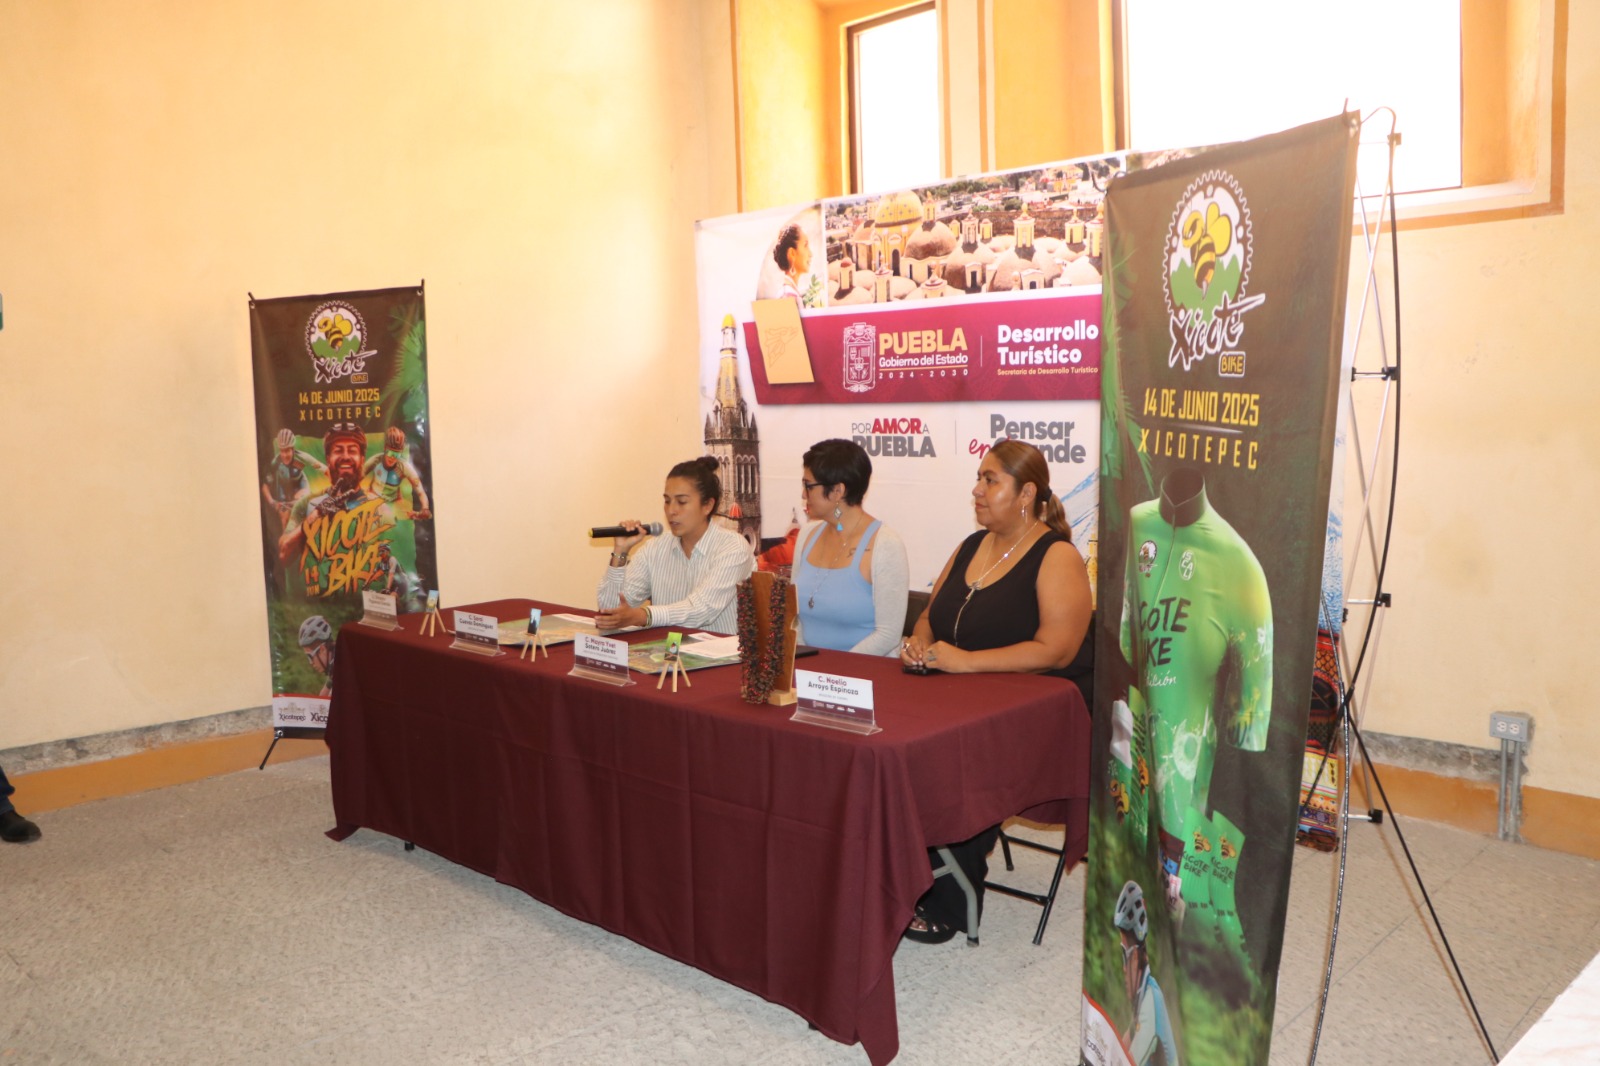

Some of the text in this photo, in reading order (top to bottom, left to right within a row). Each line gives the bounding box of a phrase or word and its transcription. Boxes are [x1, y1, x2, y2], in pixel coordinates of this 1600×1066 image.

[879, 327, 968, 355] PUEBLA
[998, 319, 1099, 344] Desarrollo
[879, 352, 968, 367] Gobierno del Estado
[997, 344, 1082, 365] Turístico
[1221, 355, 1244, 373] BIKE
[1037, 367, 1069, 375] Desarrollo
[299, 388, 380, 405] 14 DE JUNIO 2025
[300, 406, 381, 421] XICOTEPEC
[1143, 387, 1260, 427] 14 DE JUNIO 2025
[851, 417, 930, 434] POR AMOR A
[990, 413, 1075, 440] Pensar
[852, 435, 937, 457] PUEBLA
[1138, 428, 1259, 470] XICOTEPEC
[300, 498, 395, 575] XICOTE
[305, 565, 319, 585] 14
[1146, 636, 1173, 667] KE
[808, 682, 858, 695] Arroyo Espinoza
[827, 677, 847, 686] Noelia
